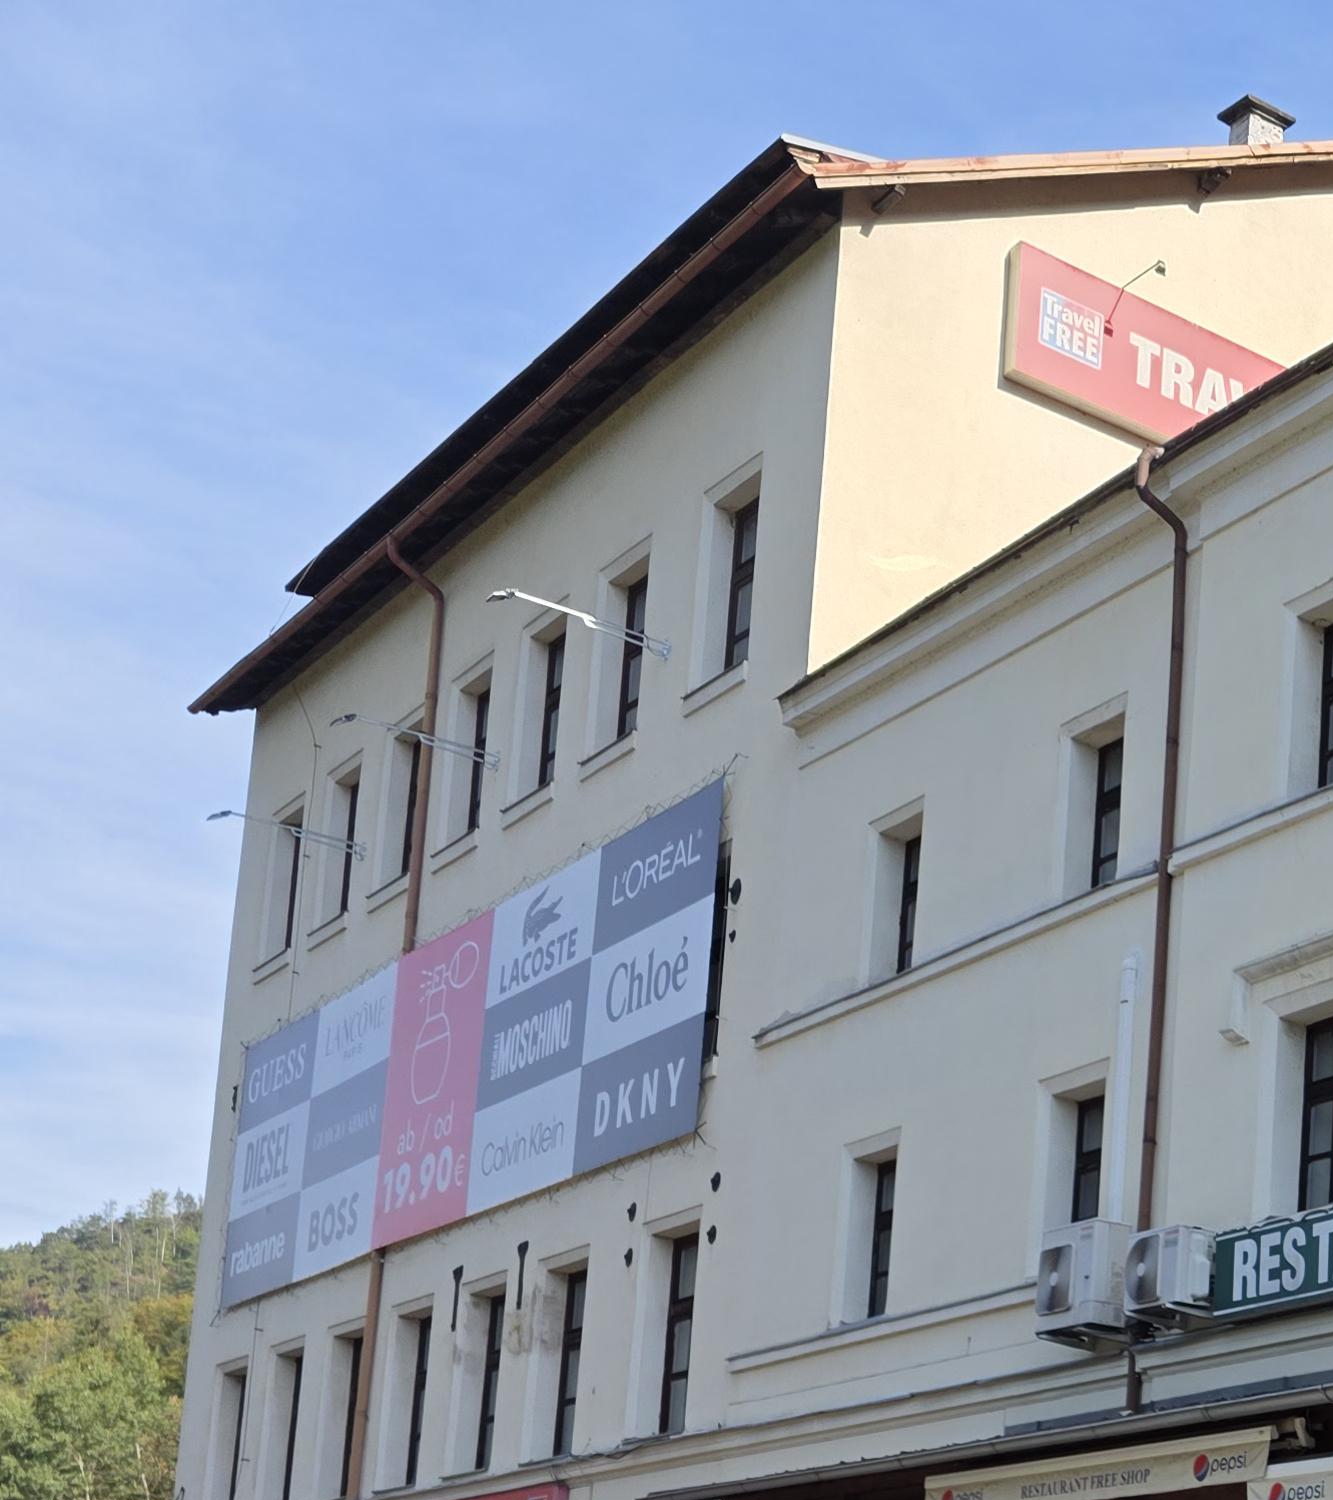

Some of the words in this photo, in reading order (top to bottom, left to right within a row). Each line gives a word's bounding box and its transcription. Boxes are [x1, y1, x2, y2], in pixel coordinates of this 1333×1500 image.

[1043, 317, 1099, 363] FREE
[1044, 293, 1101, 337] Travel
[611, 833, 701, 906] L'ORÉAL
[499, 927, 578, 995] LACOSTE
[606, 936, 690, 1023] Chloé
[497, 999, 573, 1079] MOSCHINO
[248, 1043, 306, 1104] GUESS
[593, 1058, 686, 1137] DKNY
[242, 1123, 290, 1193] DIESEL
[397, 1119, 415, 1155] ab
[434, 1099, 455, 1140] od
[481, 1132, 526, 1176] Calvin
[528, 1113, 565, 1158] Klein
[307, 1192, 360, 1252] BOSS
[229, 1232, 286, 1277] rabanne
[1020, 1476, 1090, 1500] RESTAURANT
[1091, 1472, 1119, 1490] FREE
[1120, 1468, 1150, 1486] SHOP
[1210, 1450, 1247, 1477] pepsi
